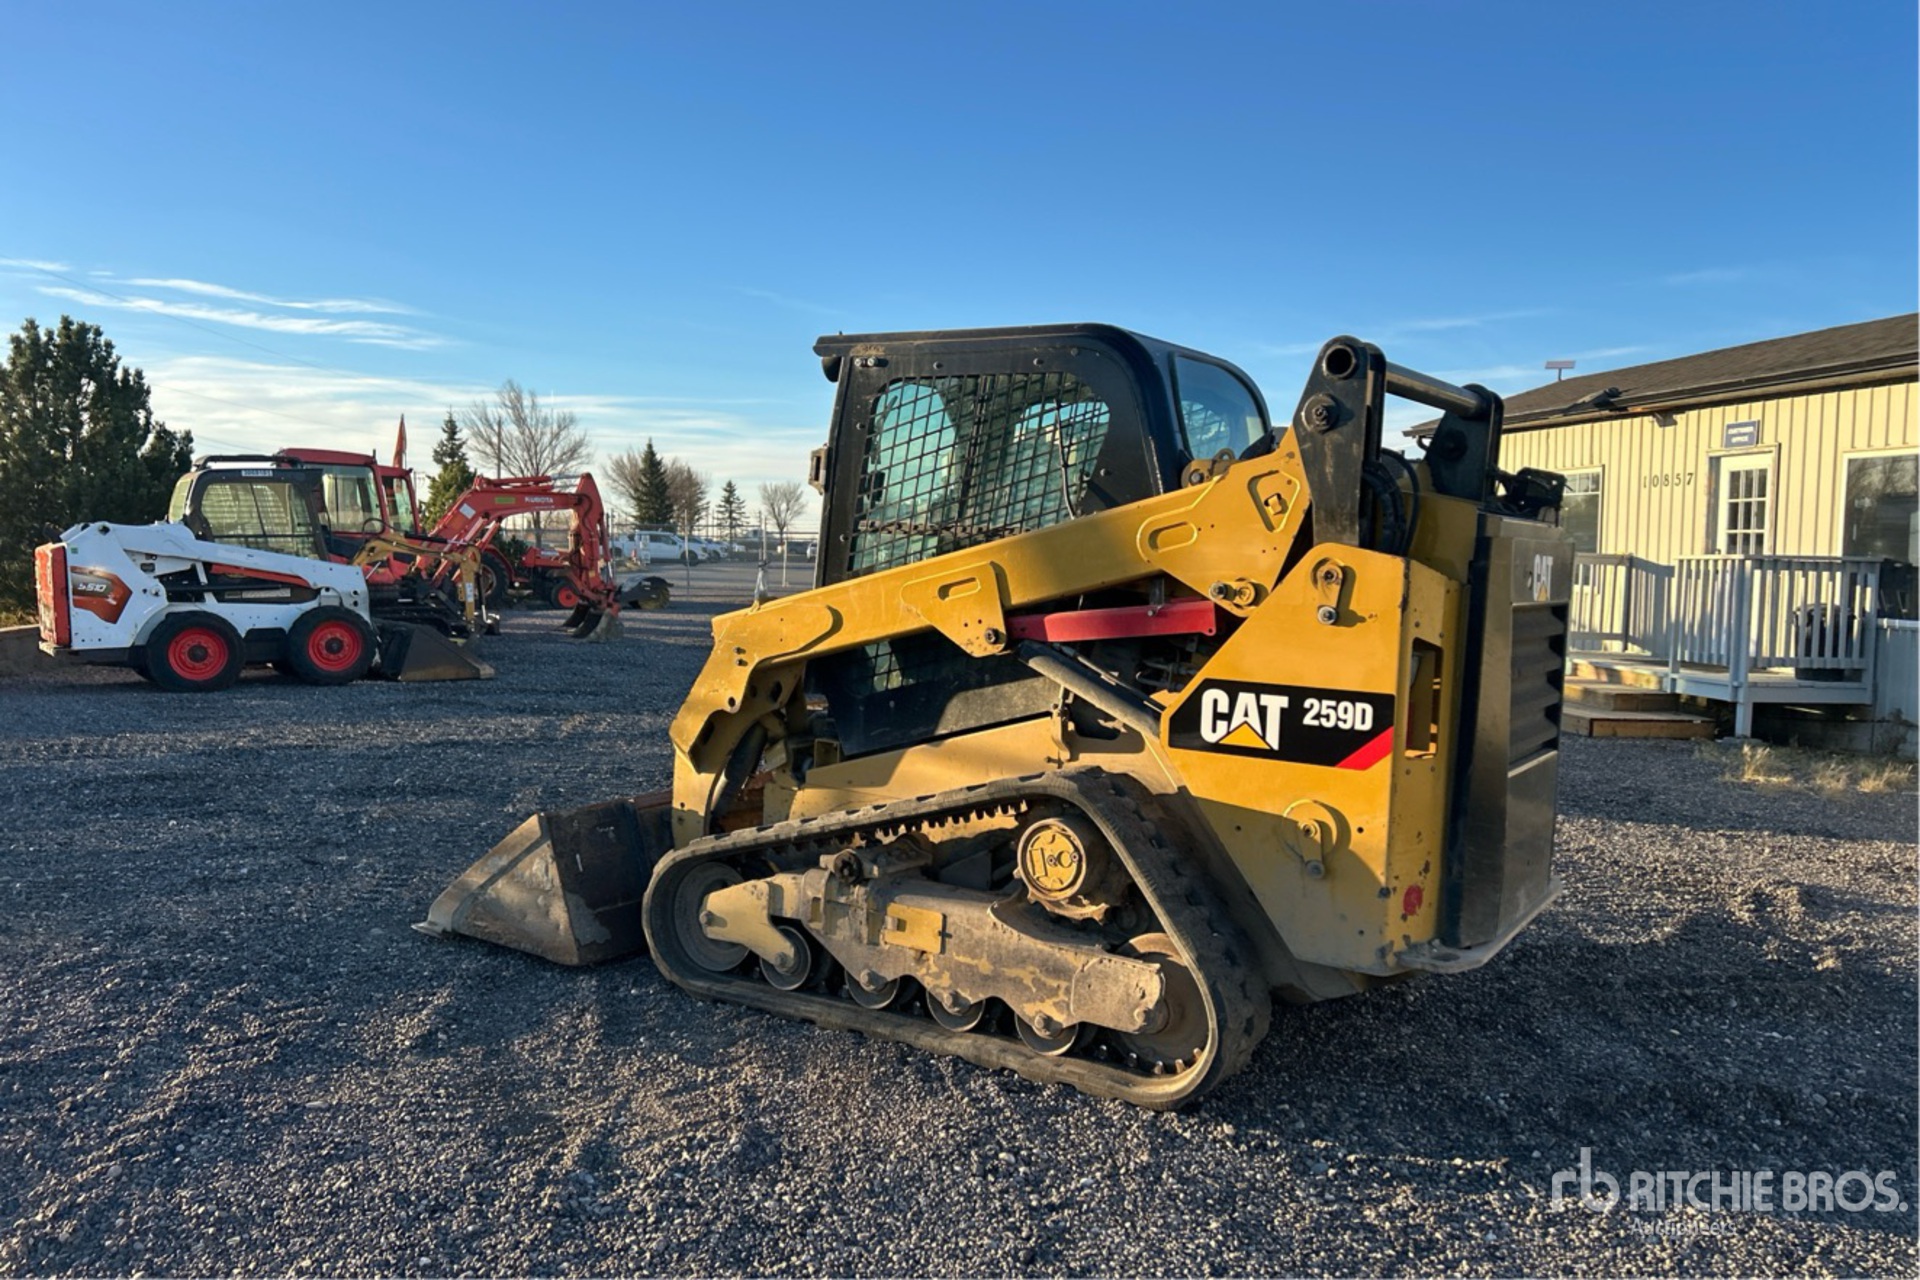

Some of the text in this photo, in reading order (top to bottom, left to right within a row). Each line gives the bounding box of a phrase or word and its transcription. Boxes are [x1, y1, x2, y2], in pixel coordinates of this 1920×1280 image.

[1643, 472, 1694, 488] 10857
[1533, 554, 1554, 602] CAT
[1201, 688, 1374, 751] CAT 259D
